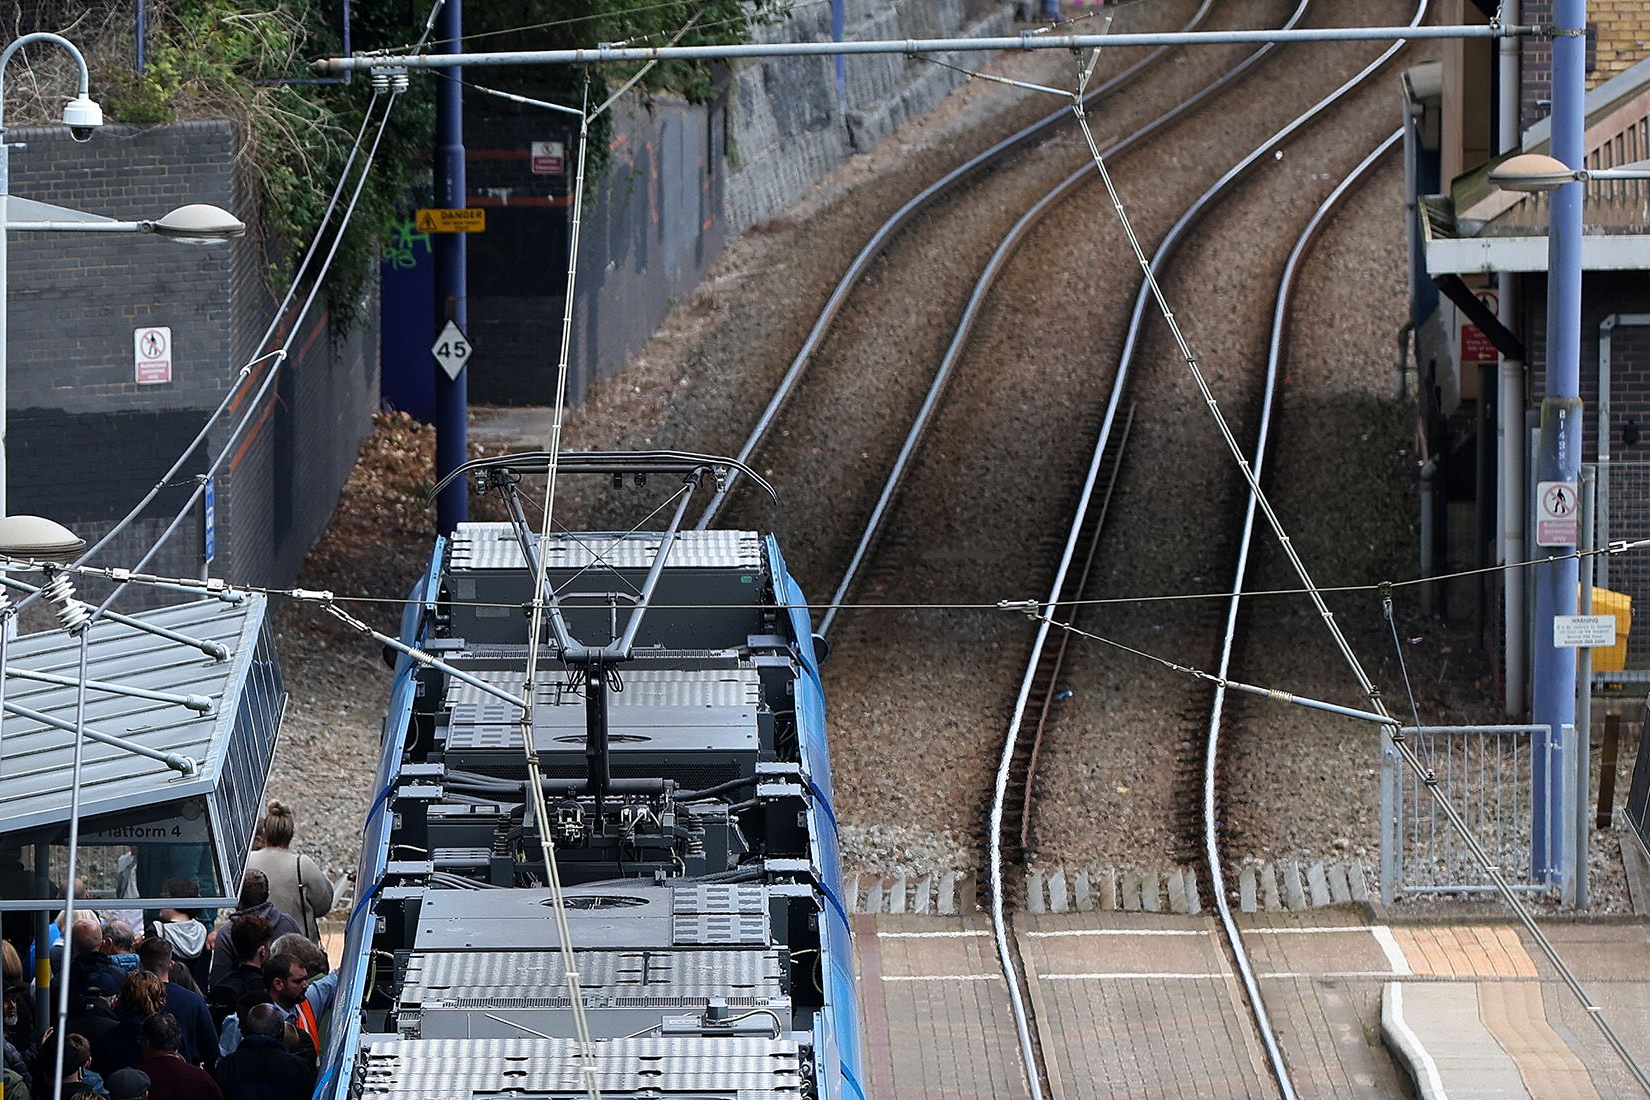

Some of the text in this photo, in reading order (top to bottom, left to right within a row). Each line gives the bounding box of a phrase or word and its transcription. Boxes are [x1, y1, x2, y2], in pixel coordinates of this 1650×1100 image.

[441, 210, 483, 219] DANGER
[437, 341, 466, 358] 45
[171, 825, 182, 837] 4
